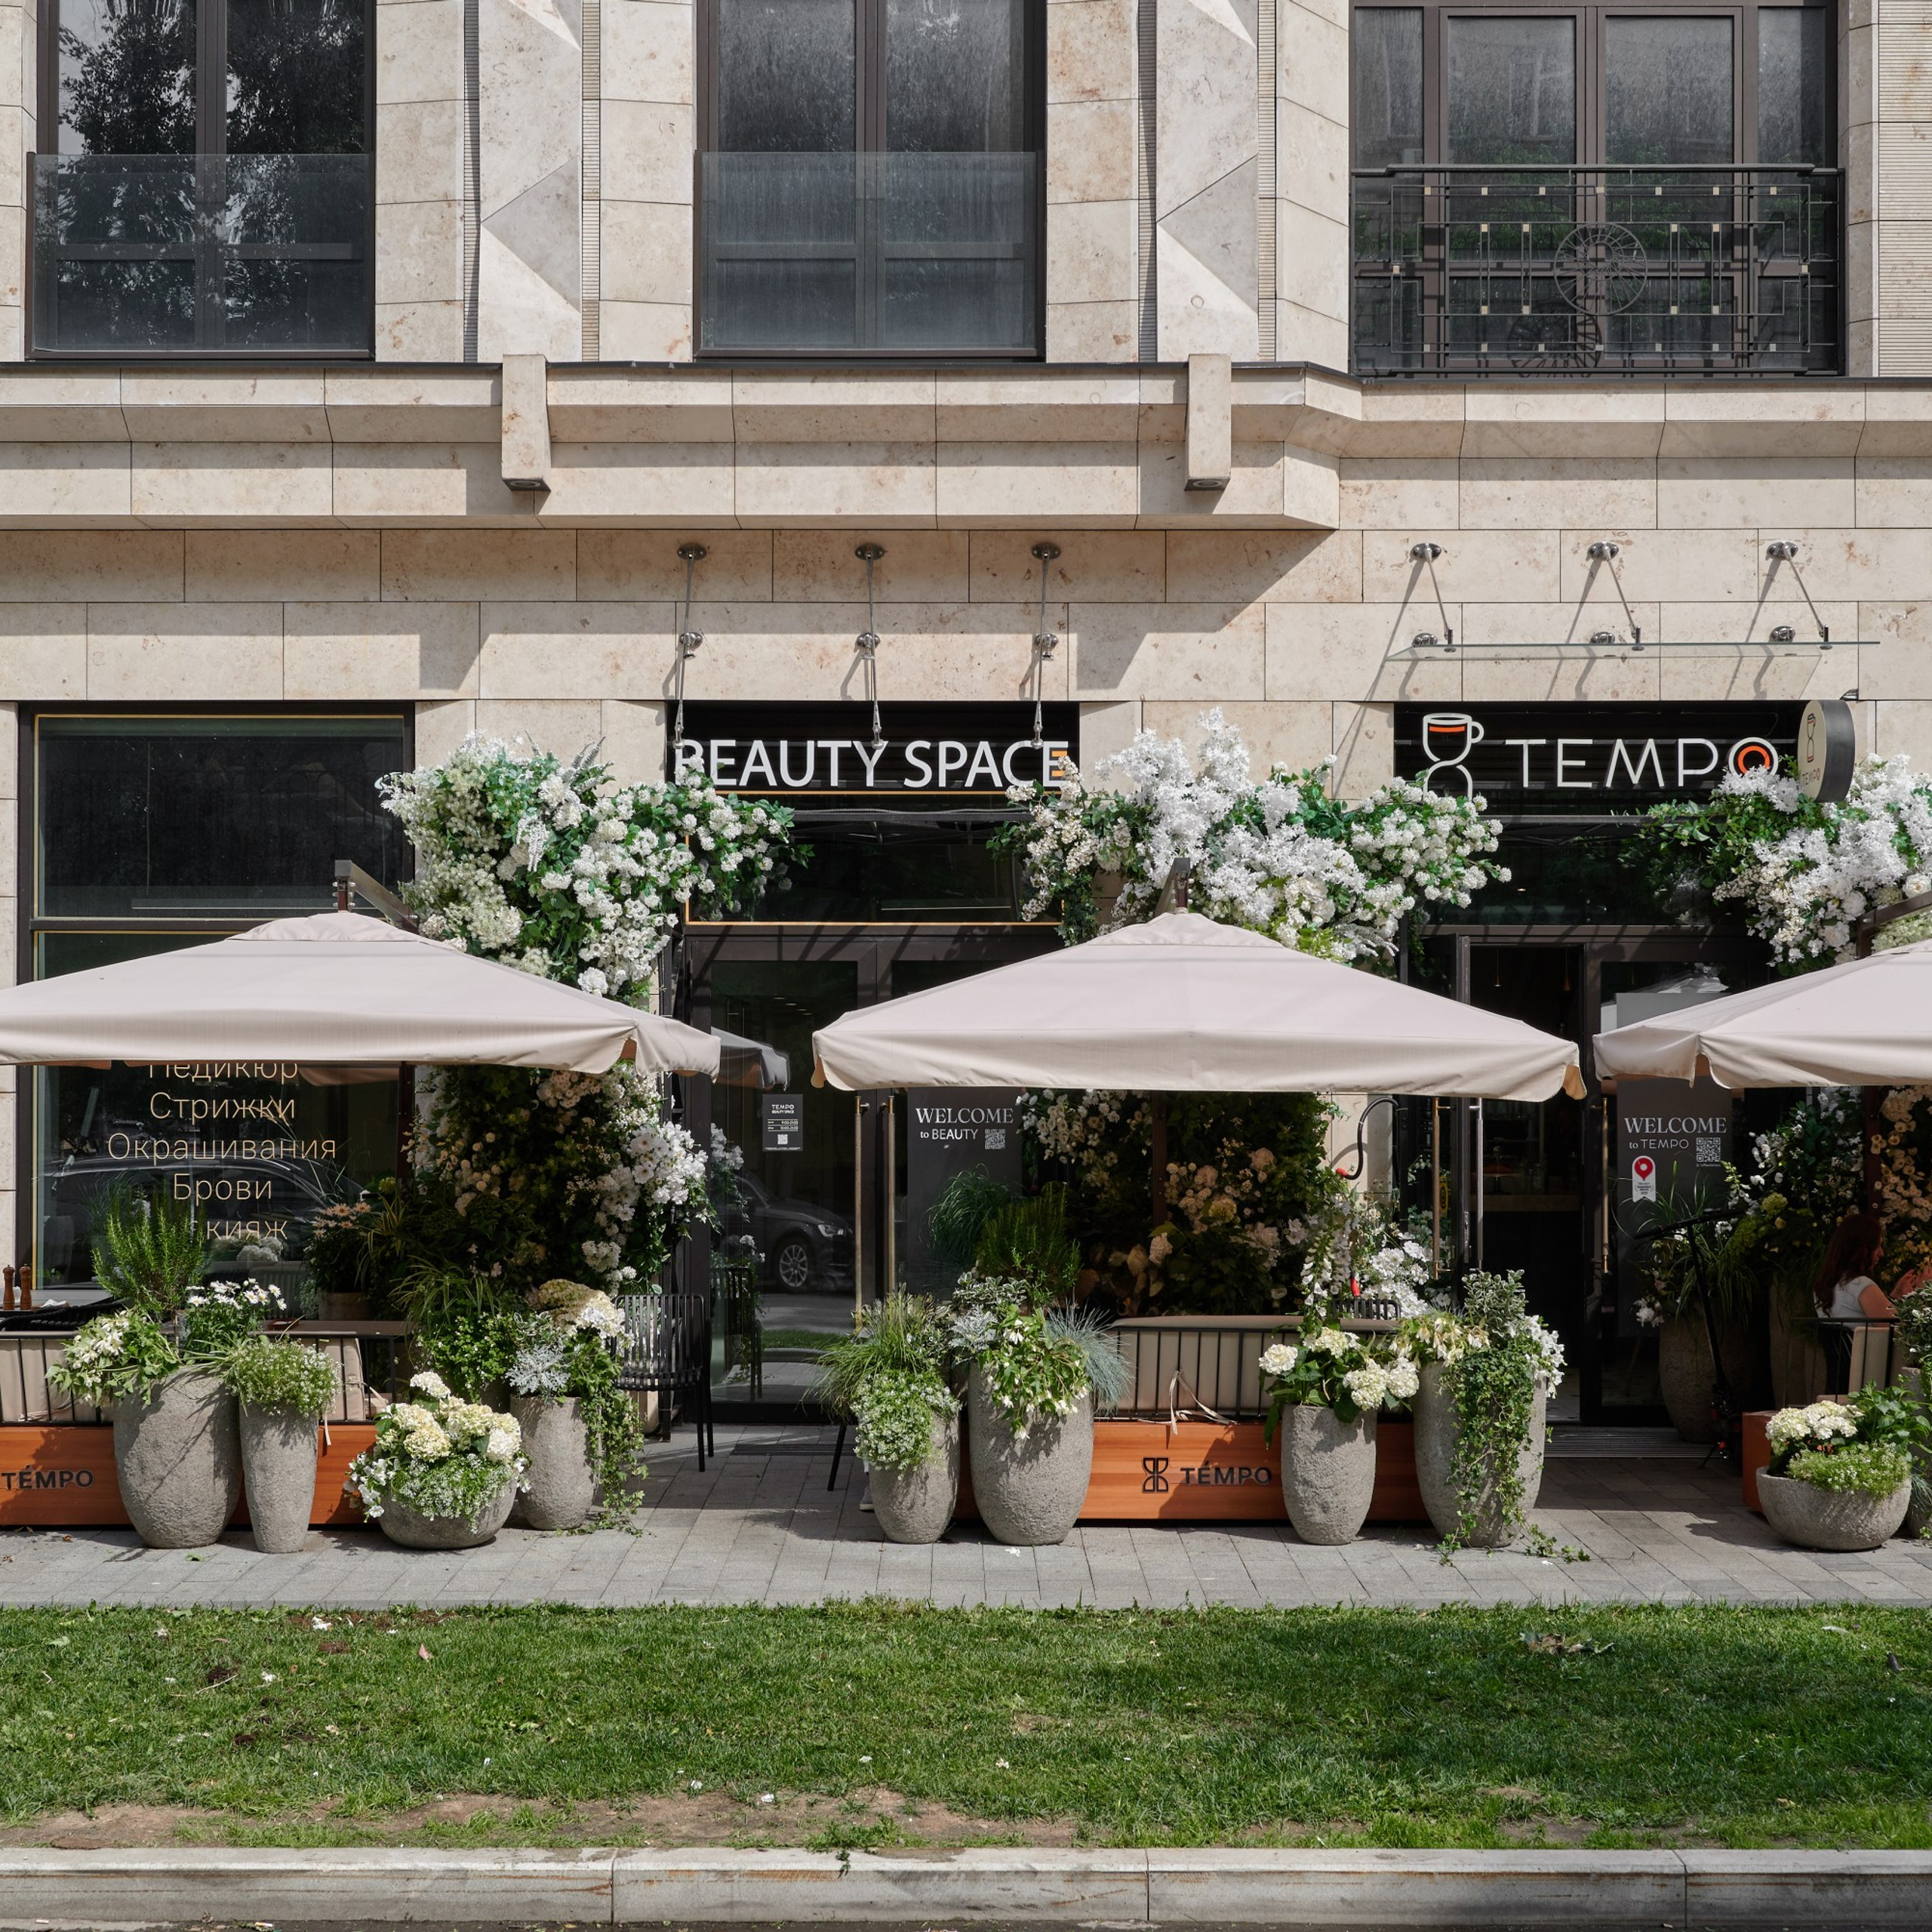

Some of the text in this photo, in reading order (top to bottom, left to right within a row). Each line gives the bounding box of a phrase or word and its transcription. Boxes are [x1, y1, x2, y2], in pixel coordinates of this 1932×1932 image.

[675, 739, 1069, 787] BEAUTY SPACE
[1504, 737, 1779, 788] TEMPO
[150, 1091, 295, 1125] Стрижки
[915, 1108, 1014, 1124] WELCOME
[920, 1128, 979, 1140] to BEAUTY
[1623, 1117, 1727, 1134] WELCOME
[107, 1132, 337, 1166] Окрашивания
[1629, 1138, 1689, 1149] to TEMPO
[174, 1173, 272, 1206] Брови
[189, 1220, 288, 1240] кияж
